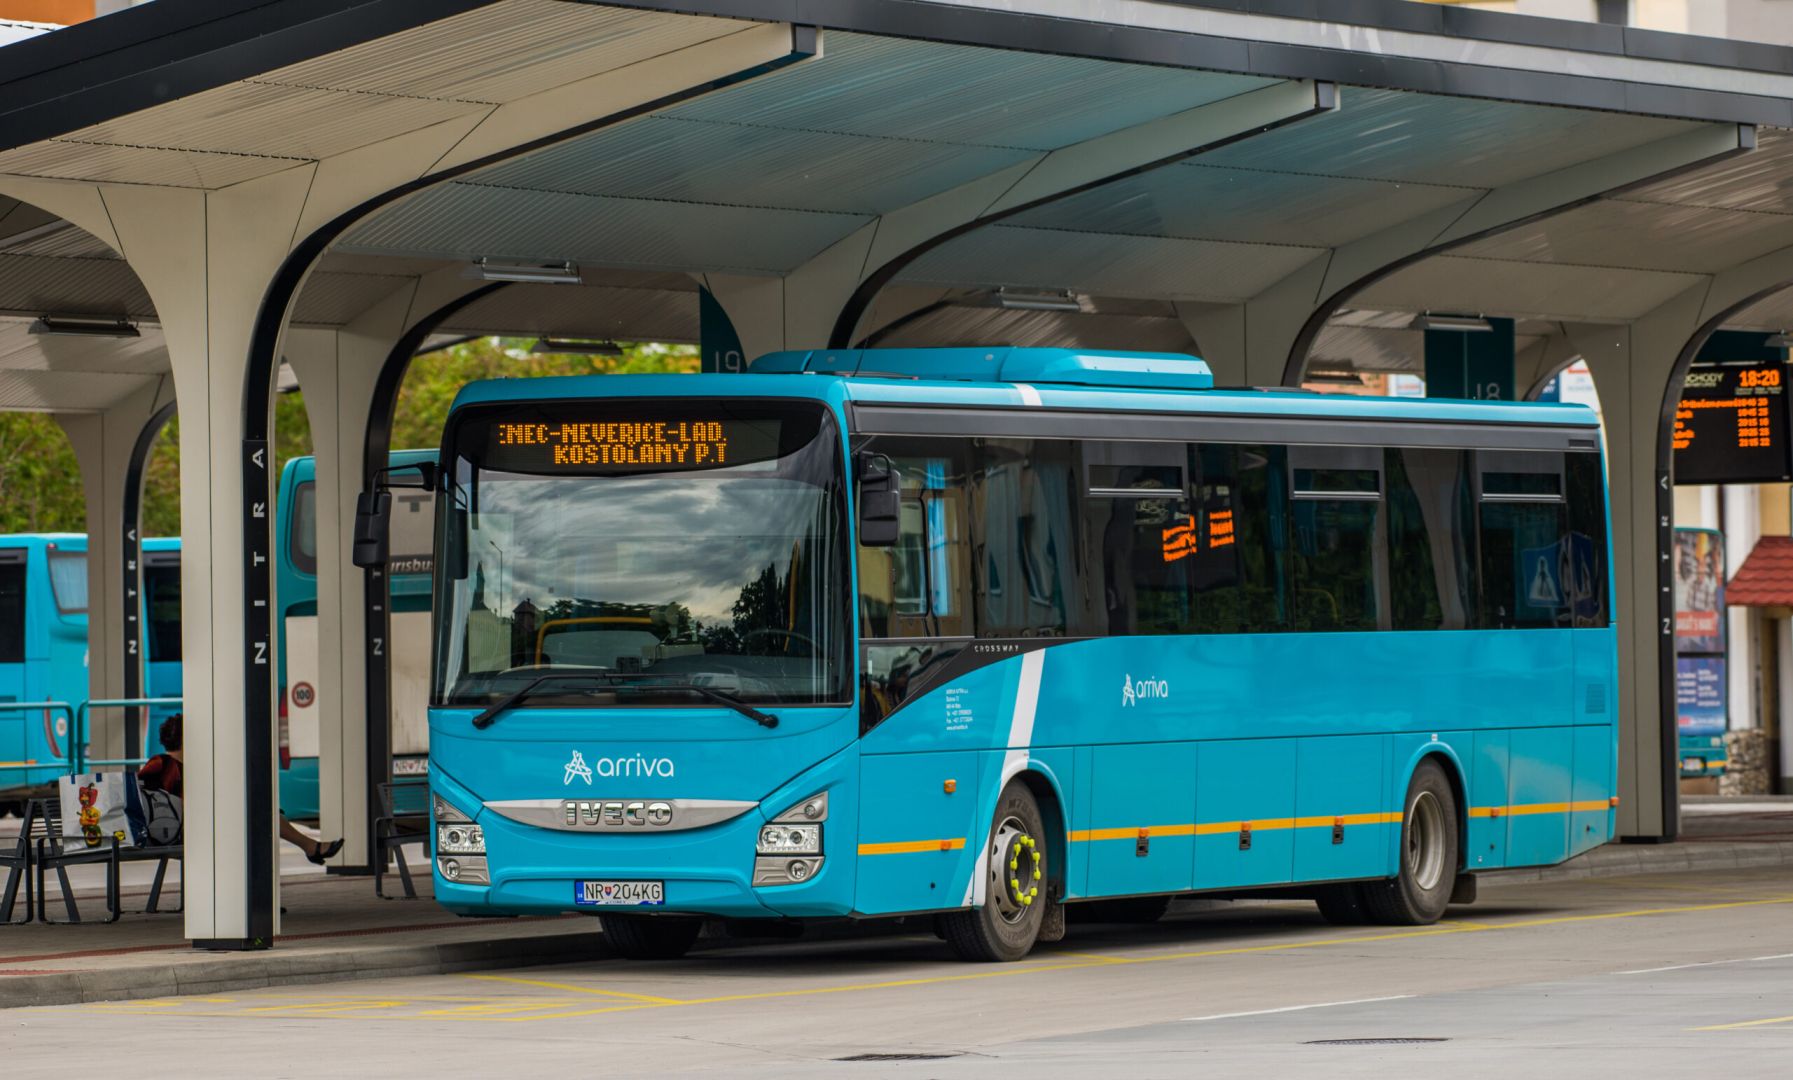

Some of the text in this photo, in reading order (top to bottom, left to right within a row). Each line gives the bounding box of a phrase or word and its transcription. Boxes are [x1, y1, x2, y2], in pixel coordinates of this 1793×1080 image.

[715, 350, 740, 373] 19
[1739, 369, 1780, 387] 18:20
[252, 448, 267, 664] NITRA
[1660, 475, 1671, 634] NITRA
[127, 529, 137, 654] NITRA
[372, 567, 383, 655] NIT
[974, 644, 1019, 653] CROSSWAY
[296, 688, 312, 700] 100
[1135, 675, 1169, 699] arriva
[596, 752, 675, 778] arriva
[566, 801, 673, 827] IVECO
[585, 883, 661, 900] NR 204KG
